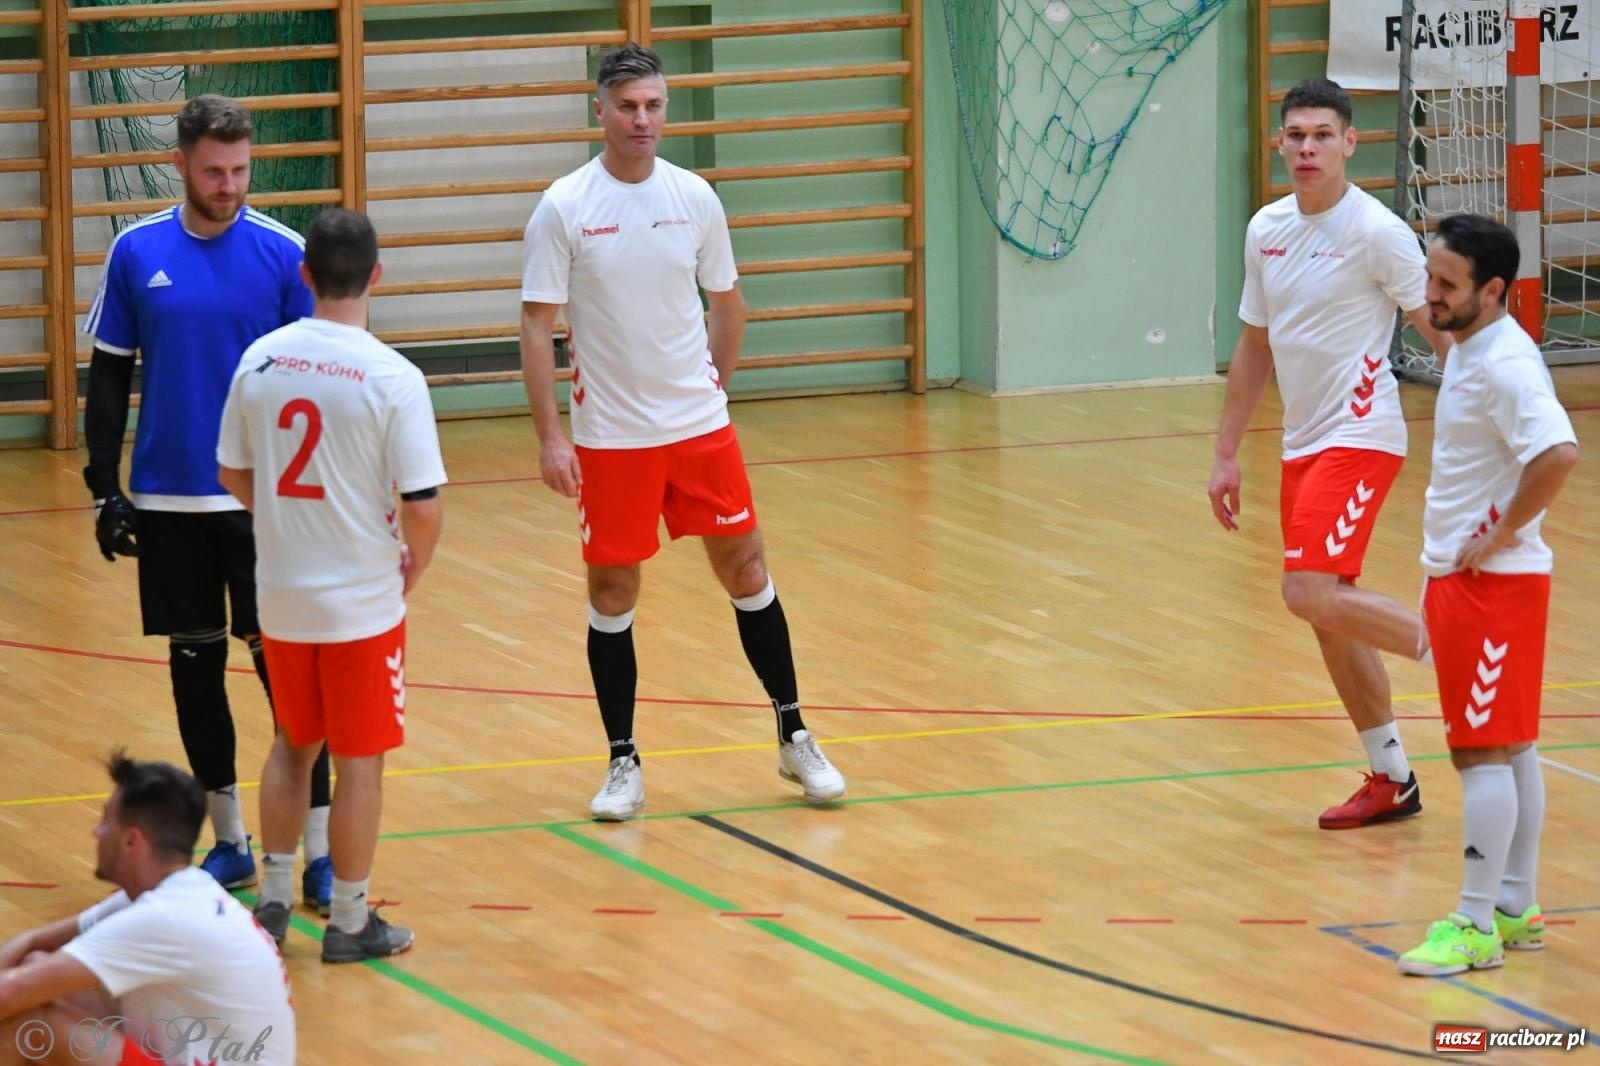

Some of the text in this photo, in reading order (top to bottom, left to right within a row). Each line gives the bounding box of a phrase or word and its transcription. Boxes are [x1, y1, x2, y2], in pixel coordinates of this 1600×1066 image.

[1385, 5, 1580, 52] RACIBRZ
[582, 224, 619, 237] hummel
[277, 398, 325, 499] 2
[716, 507, 749, 525] hummel
